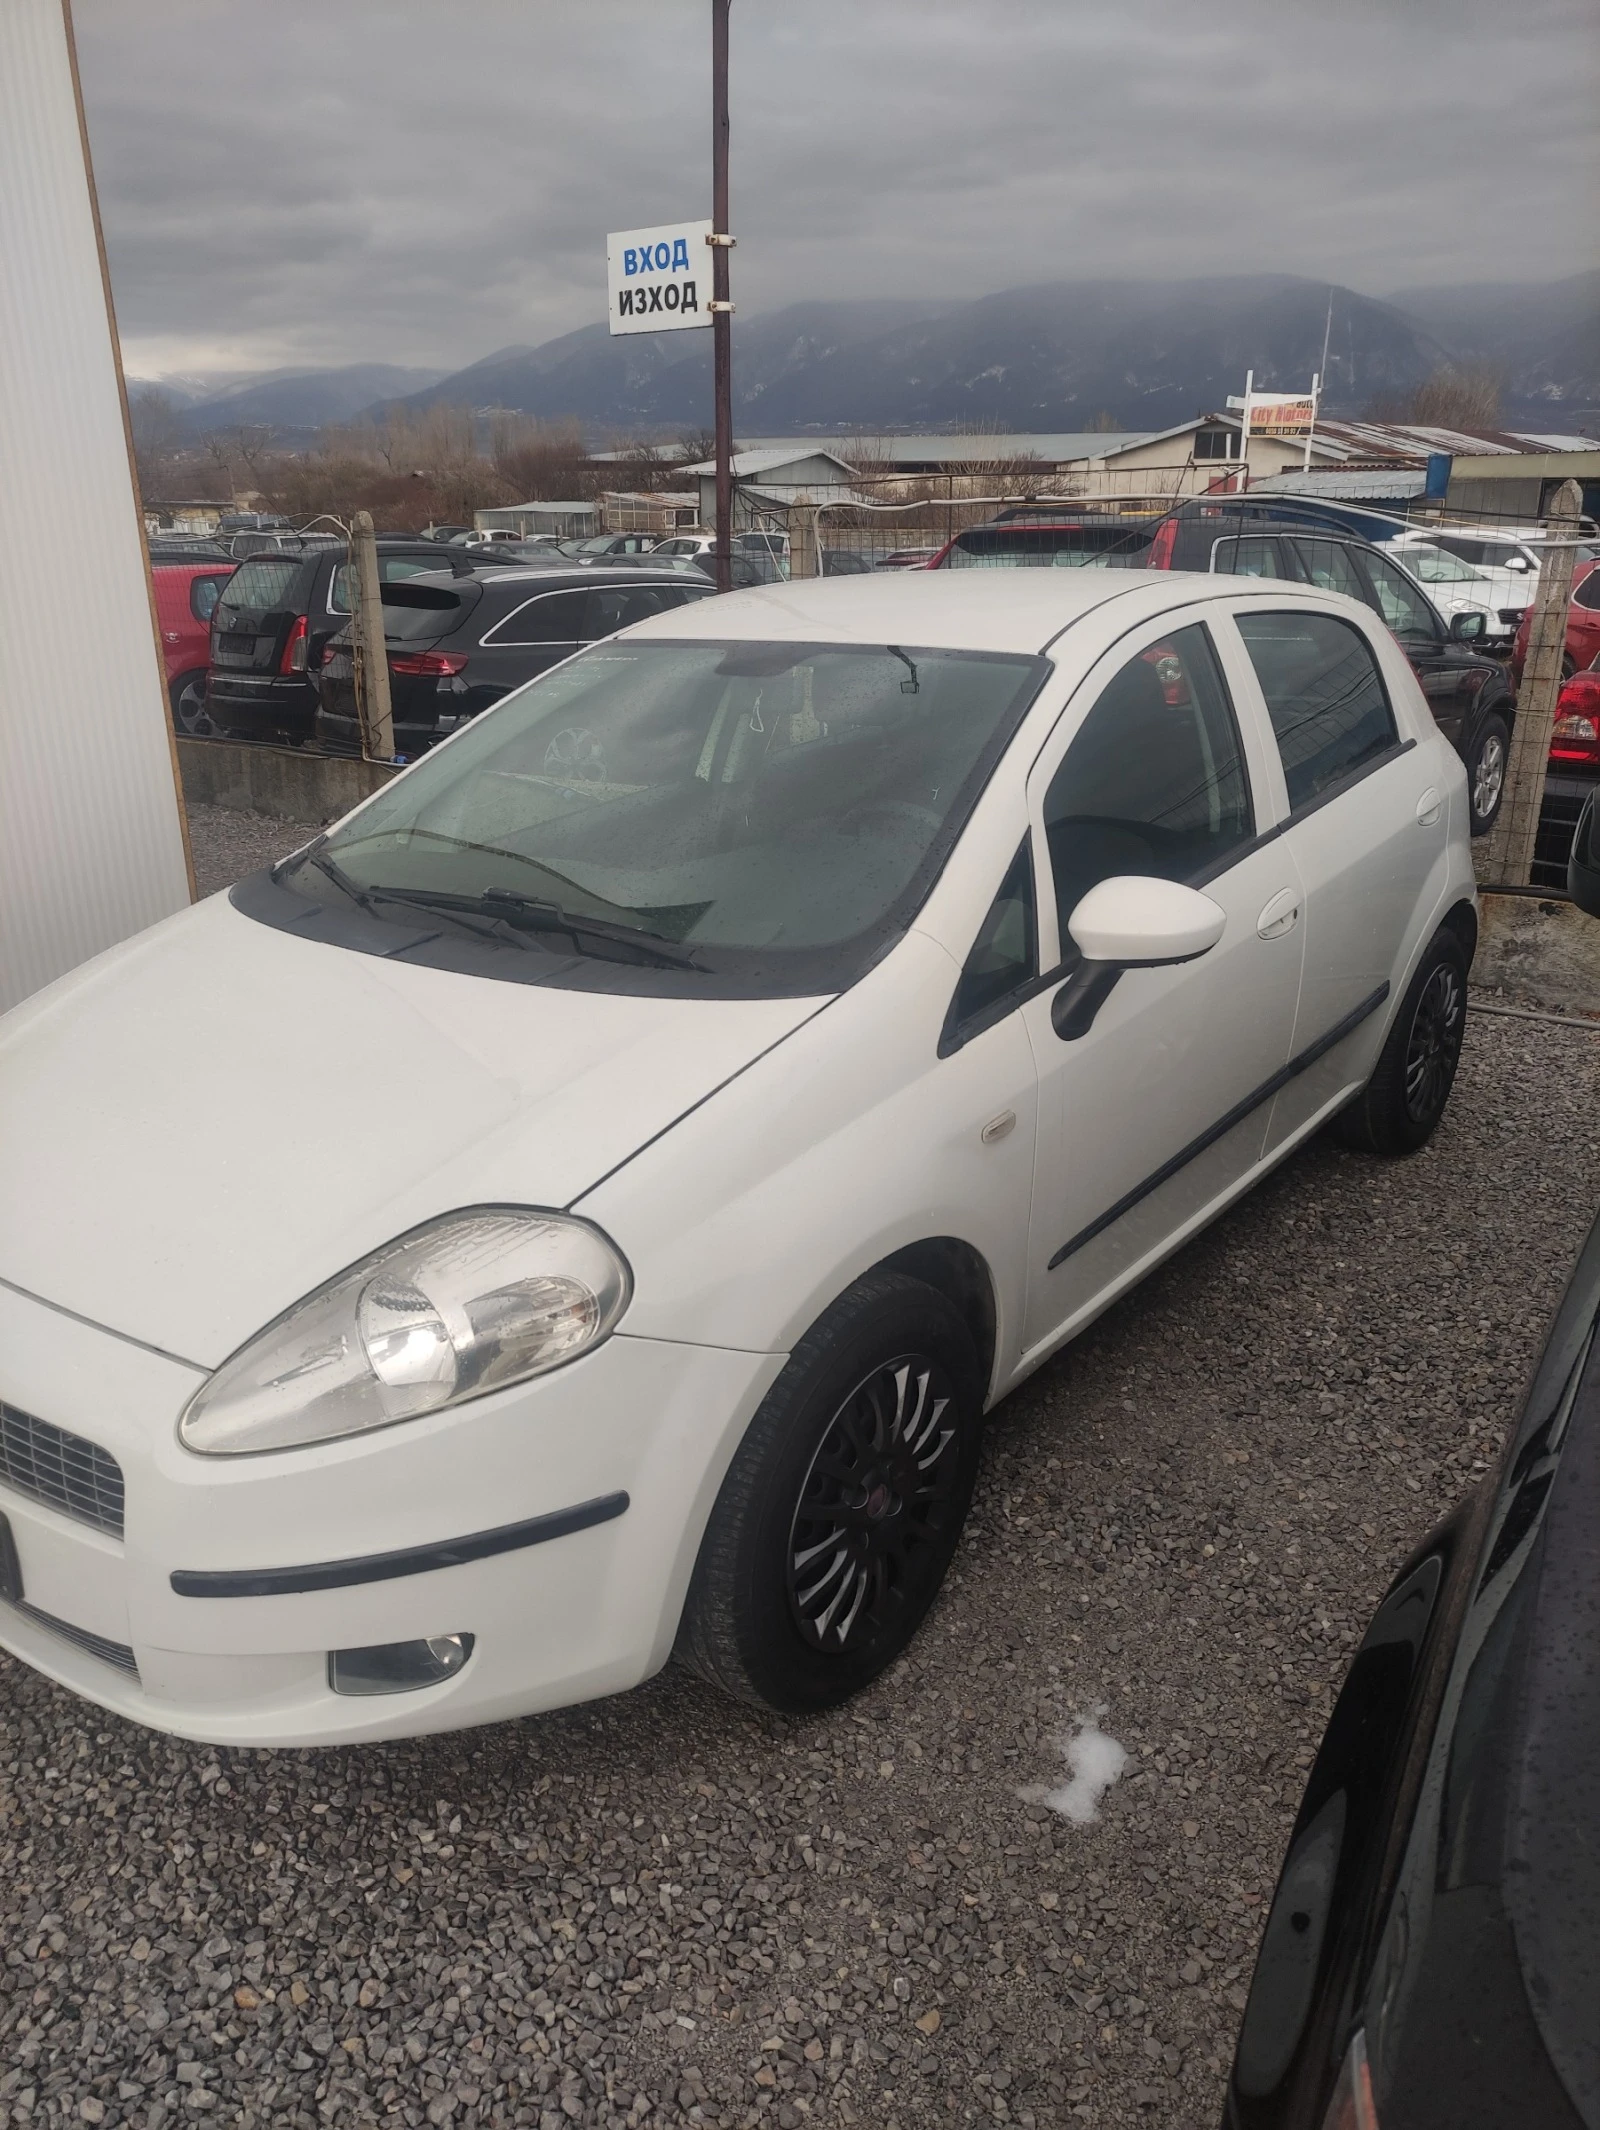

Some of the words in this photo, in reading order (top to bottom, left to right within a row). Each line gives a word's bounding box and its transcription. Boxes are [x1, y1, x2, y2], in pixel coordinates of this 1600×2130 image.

[624, 239, 689, 276] ВХОД
[619, 281, 698, 317] ИЗХОД
[1275, 406, 1312, 422] Motors
